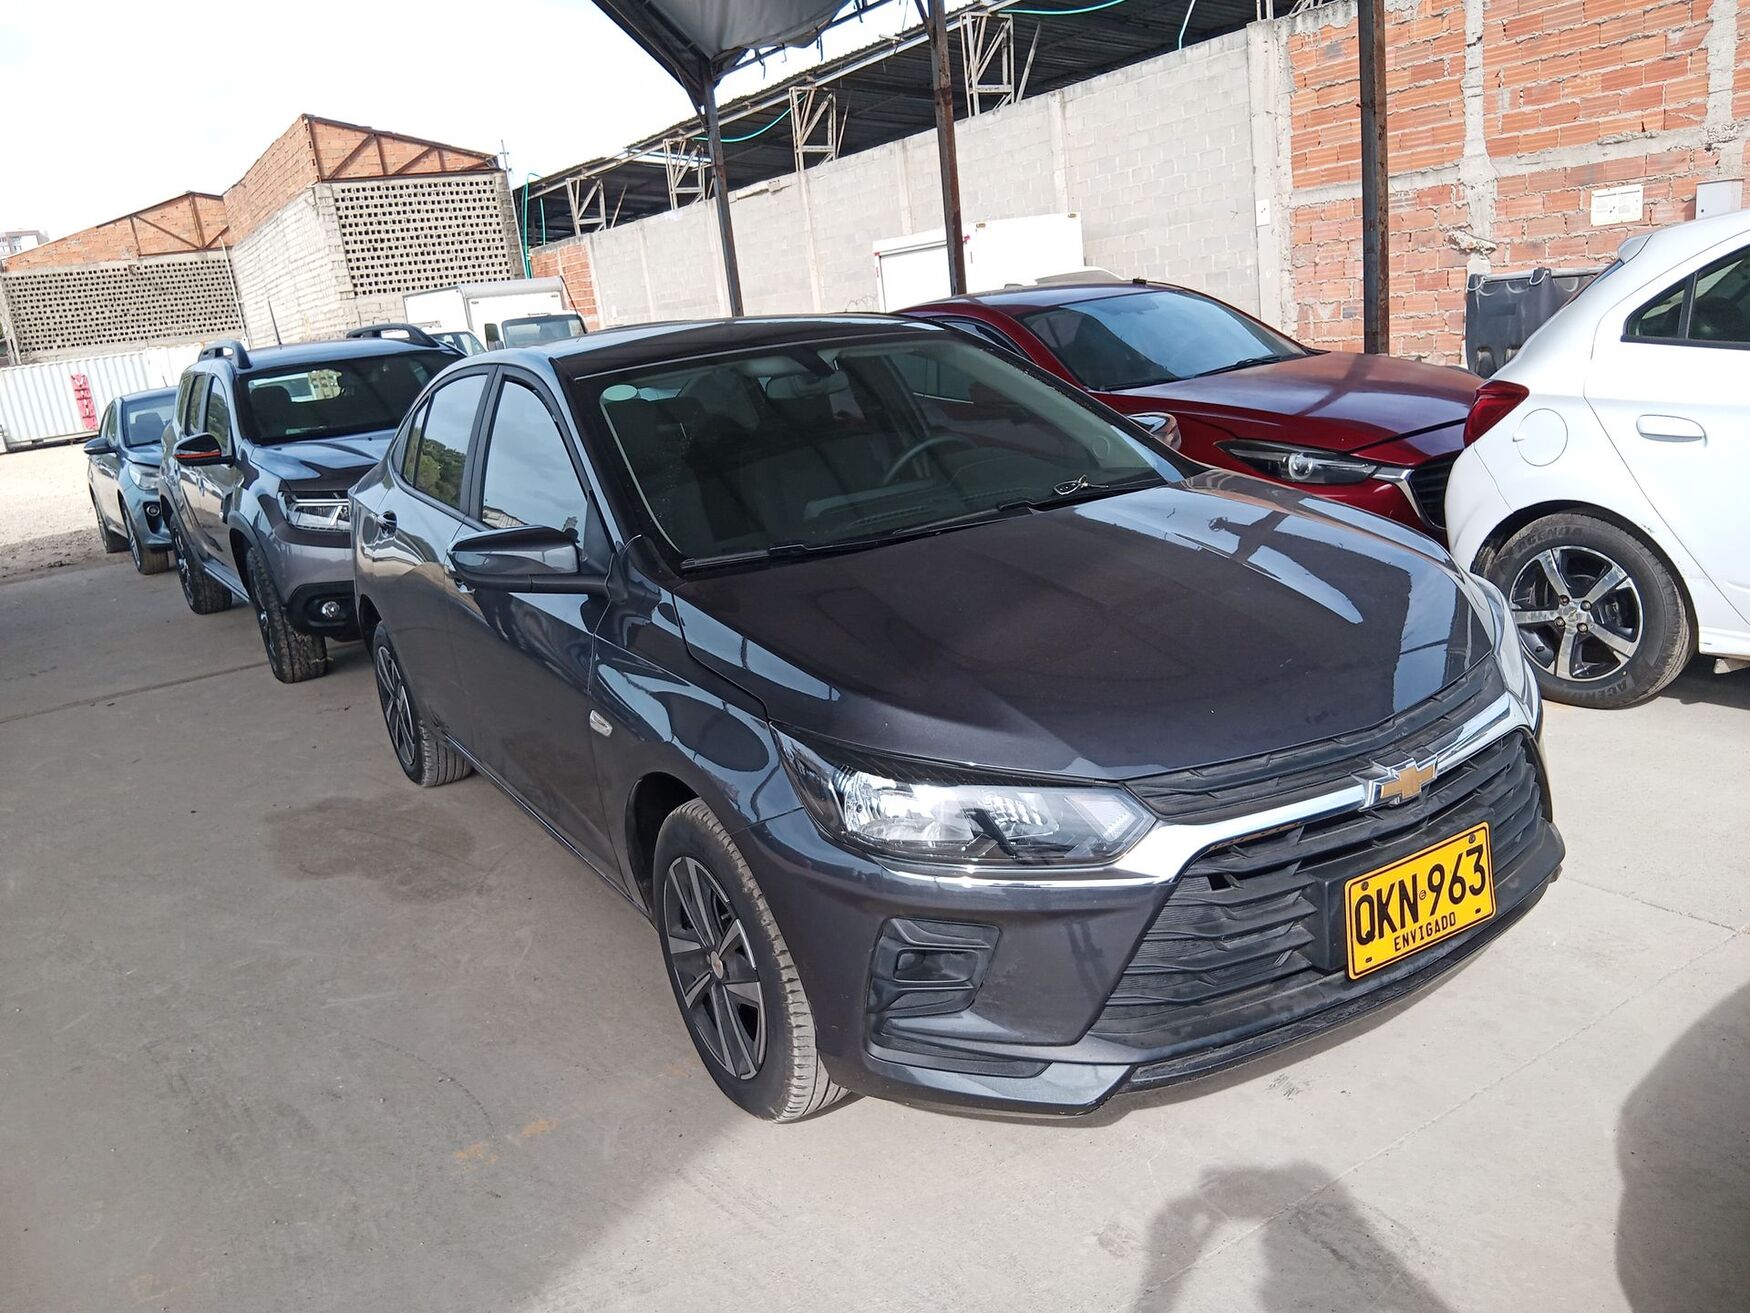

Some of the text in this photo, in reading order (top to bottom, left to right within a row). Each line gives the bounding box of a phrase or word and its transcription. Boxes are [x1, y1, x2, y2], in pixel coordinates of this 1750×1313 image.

[1354, 843, 1486, 946] QKN 963
[1393, 911, 1456, 952] ENVIGADO
